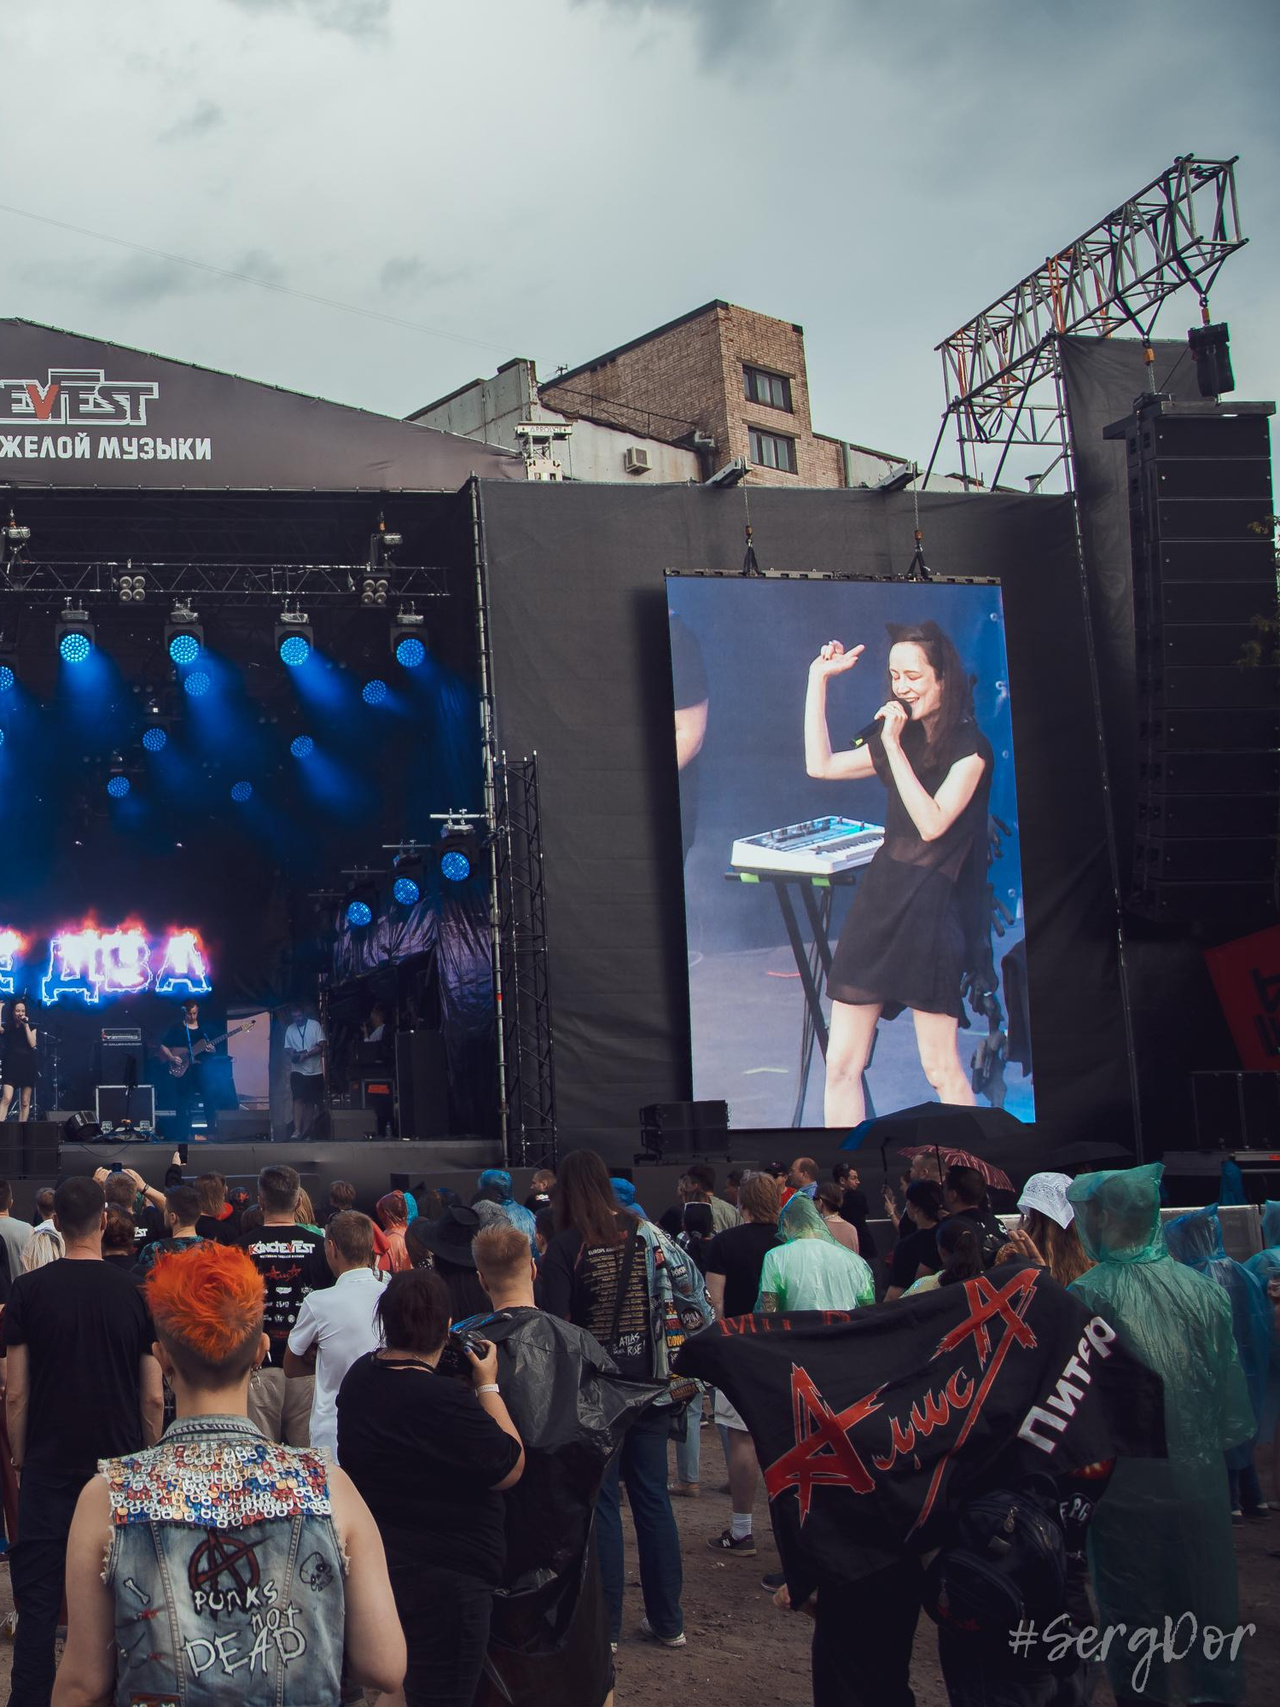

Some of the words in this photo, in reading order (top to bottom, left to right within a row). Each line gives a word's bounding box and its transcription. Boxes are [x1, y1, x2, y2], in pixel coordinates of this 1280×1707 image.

[97, 437, 212, 460] МУЗЫКИ
[42, 932, 213, 1006] ДВА
[250, 1604, 302, 1631] not
[183, 1626, 307, 1678] DEAD
